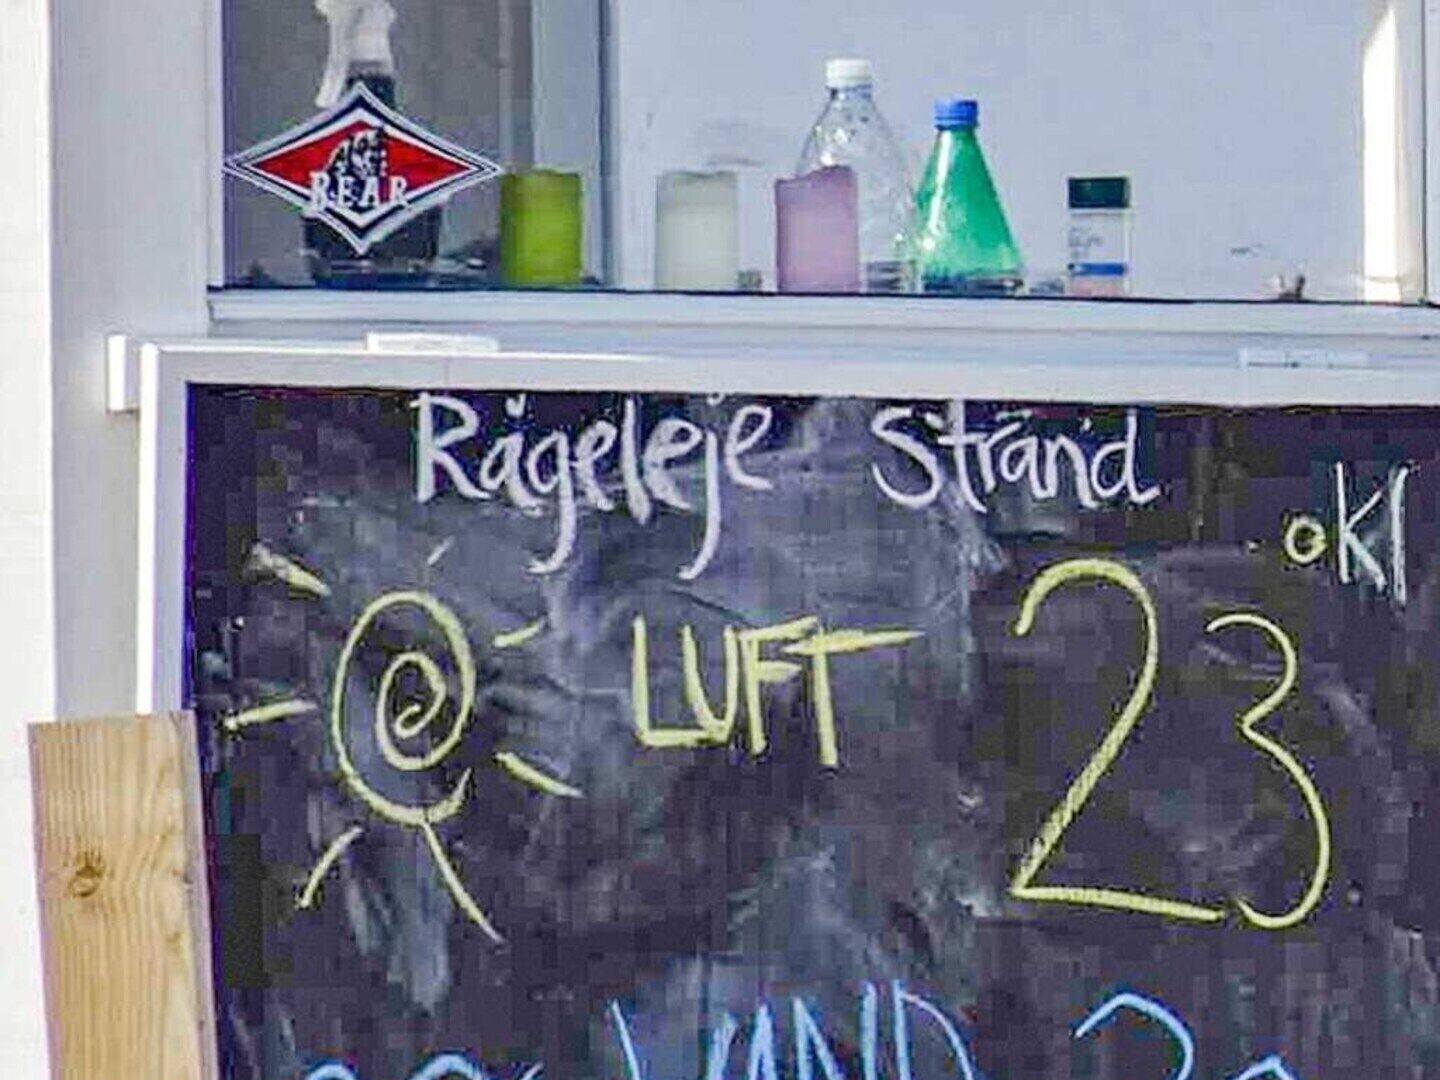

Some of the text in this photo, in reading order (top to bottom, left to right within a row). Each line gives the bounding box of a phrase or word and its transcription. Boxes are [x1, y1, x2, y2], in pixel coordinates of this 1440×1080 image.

[411, 393, 1161, 579] Rågeleje Strand
[633, 612, 924, 767] LUFT
